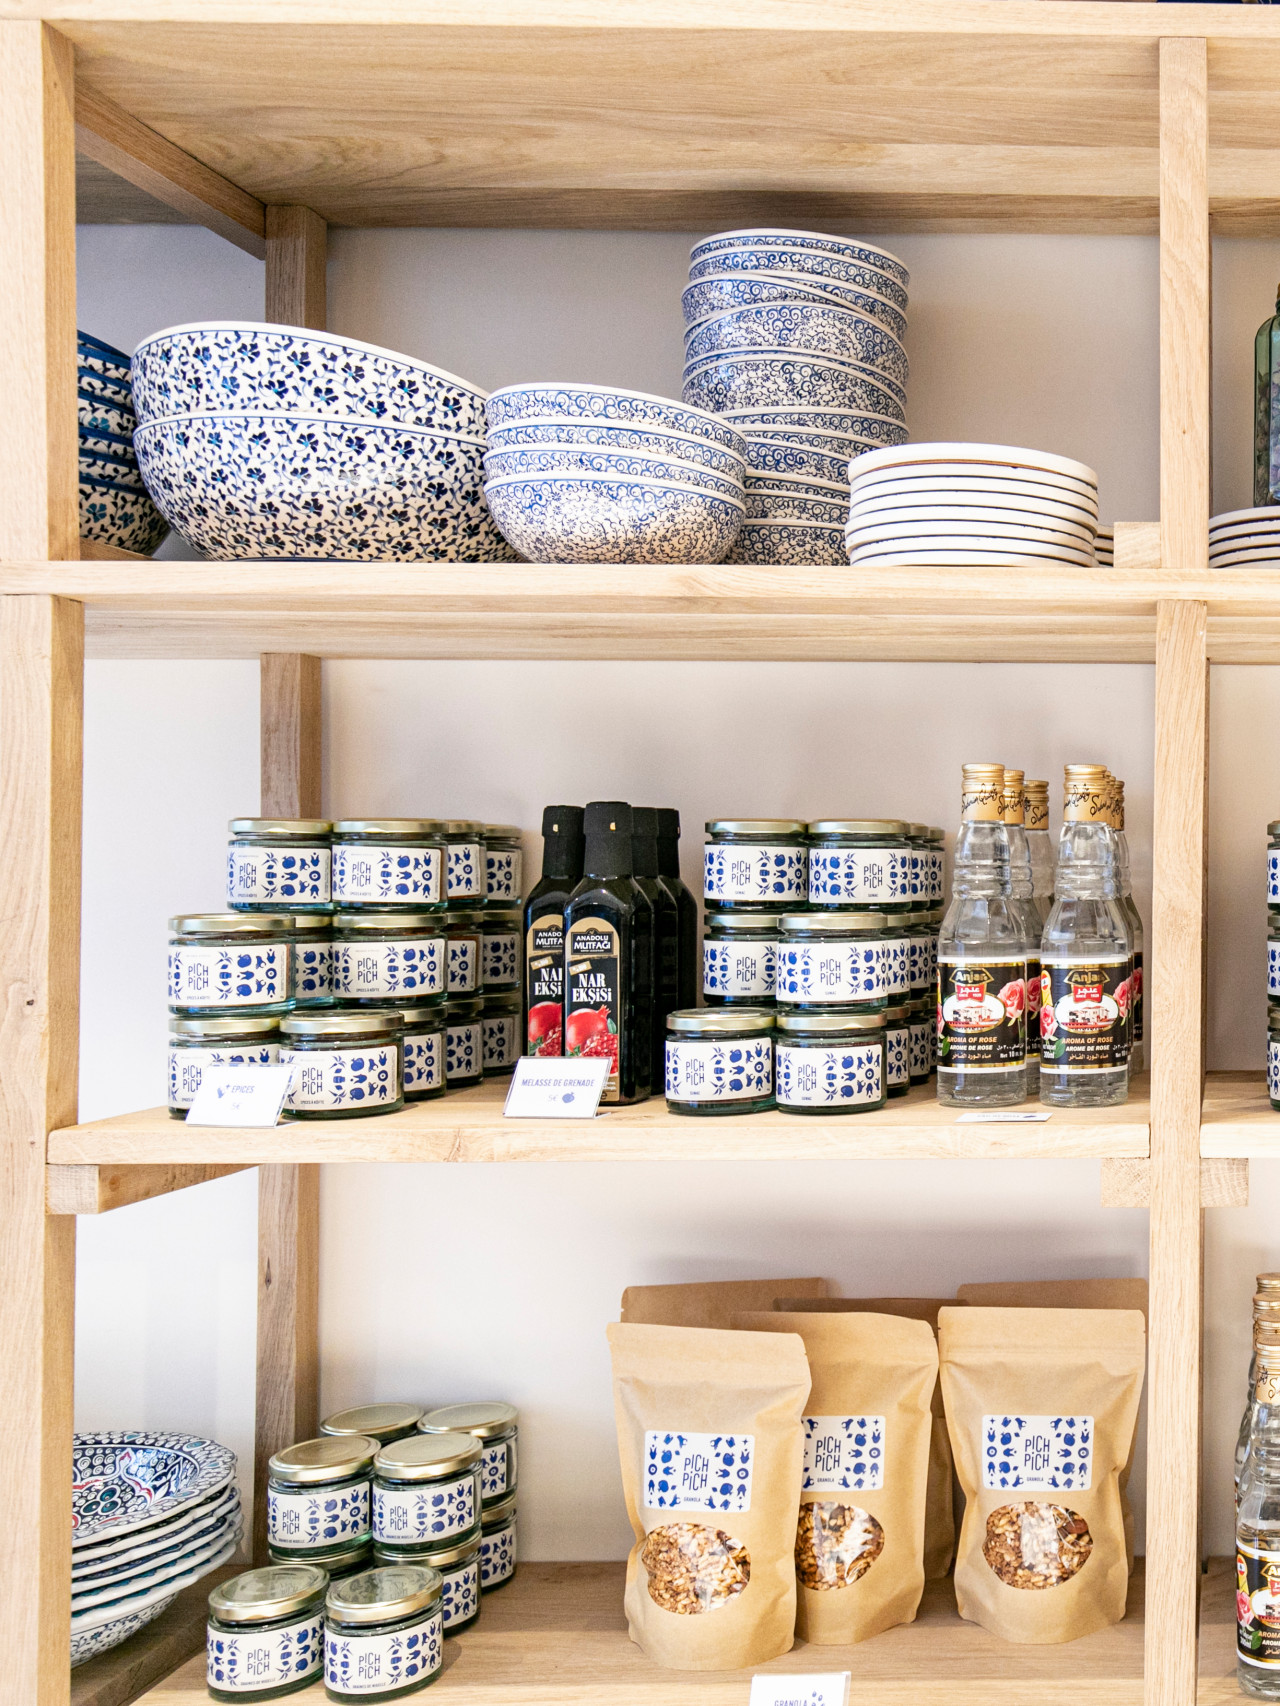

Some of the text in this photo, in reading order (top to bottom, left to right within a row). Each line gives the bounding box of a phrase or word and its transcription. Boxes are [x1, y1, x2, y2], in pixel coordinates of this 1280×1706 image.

[536, 937, 563, 946] MUTFA
[574, 941, 610, 950] MUTFAĞI
[578, 973, 606, 988] NAR
[535, 982, 562, 997] EKŞi
[521, 1079, 595, 1087] MELASSE DE GRENADE
[231, 1085, 255, 1094] EPICES
